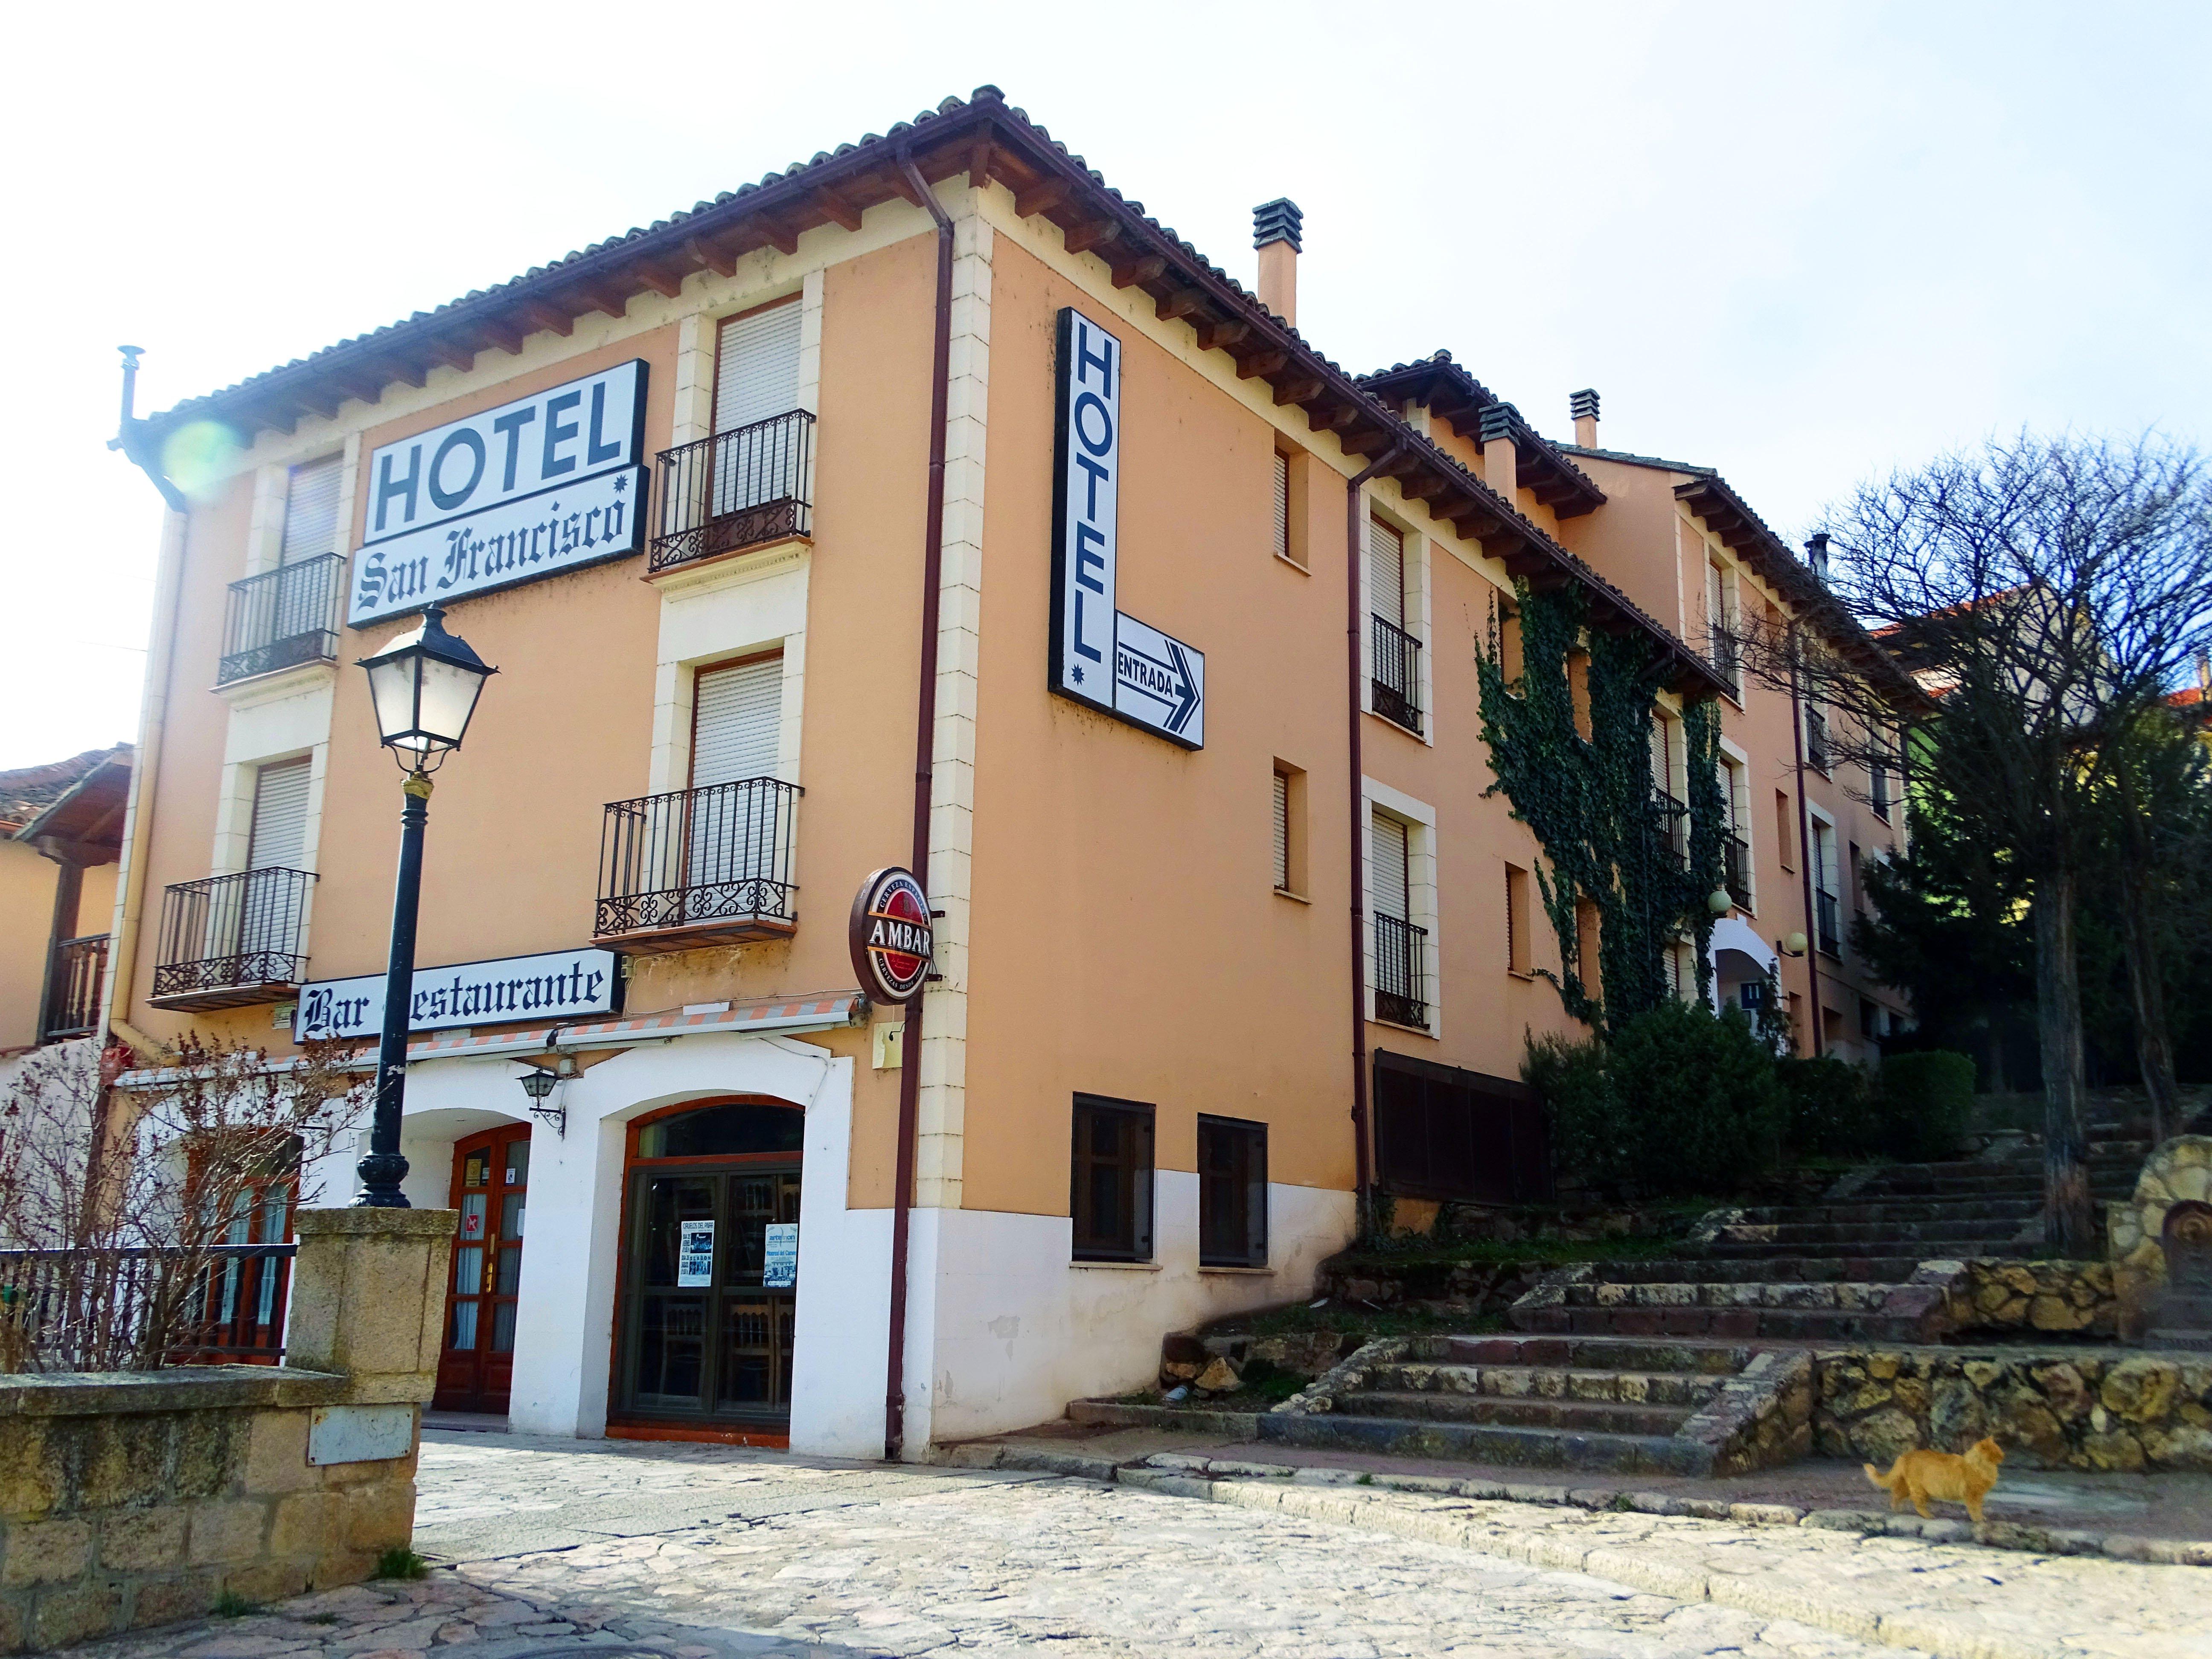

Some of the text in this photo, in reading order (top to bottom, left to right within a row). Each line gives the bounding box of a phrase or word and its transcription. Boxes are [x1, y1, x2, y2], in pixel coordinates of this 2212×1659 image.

[375, 381, 621, 531] HOTEL
[1074, 321, 1113, 664] HOTEL
[358, 500, 627, 609] San Francisco
[1118, 651, 1175, 698] ENTRADA
[880, 881, 903, 908] CERVEZA
[869, 920, 931, 958] AMBAR
[304, 960, 604, 1033] Bar estaurante
[879, 958, 898, 988] CERVEZAS
[899, 981, 914, 990] DESDE
